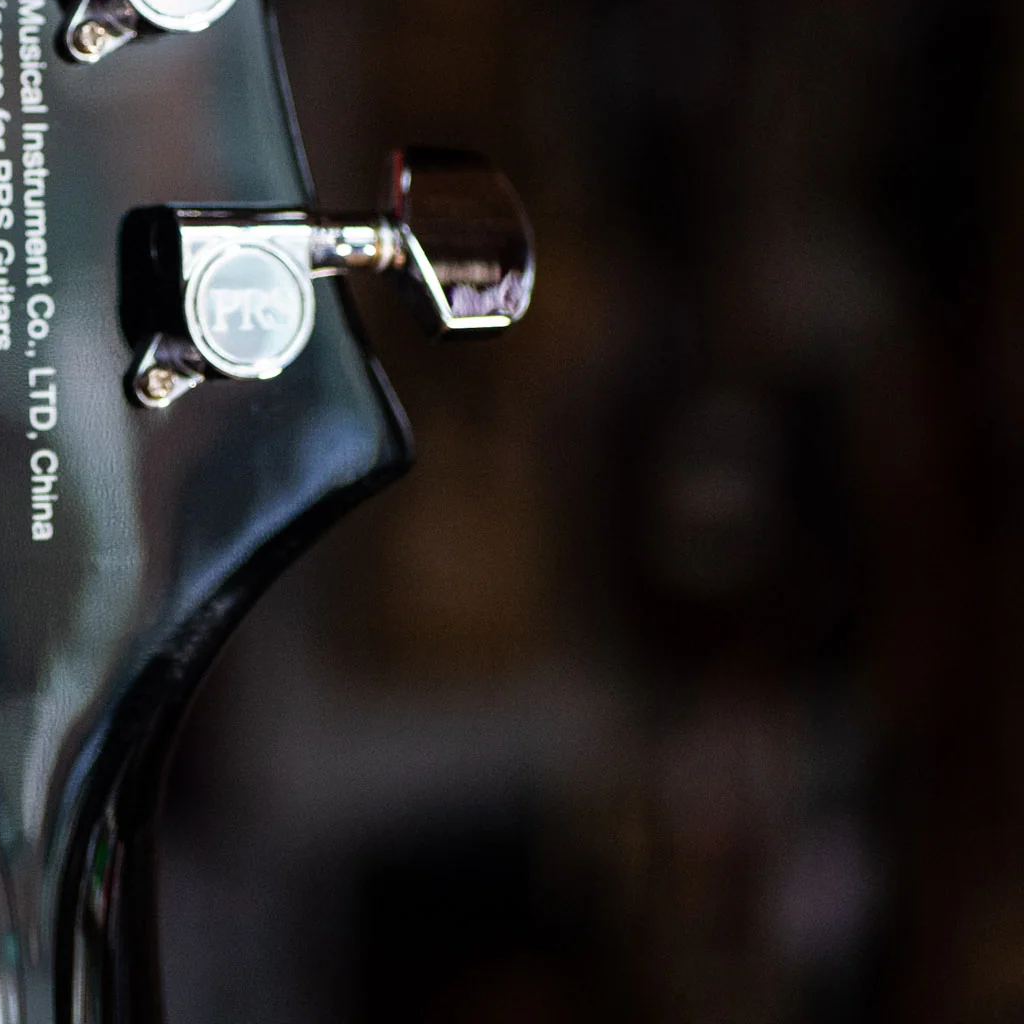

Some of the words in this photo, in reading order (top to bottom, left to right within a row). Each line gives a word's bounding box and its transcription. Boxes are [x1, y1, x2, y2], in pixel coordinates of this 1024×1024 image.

[22, 122, 52, 287] Instrument
[25, 293, 56, 358] Co.,
[26, 366, 57, 441] LTD,
[30, 448, 59, 541] China
